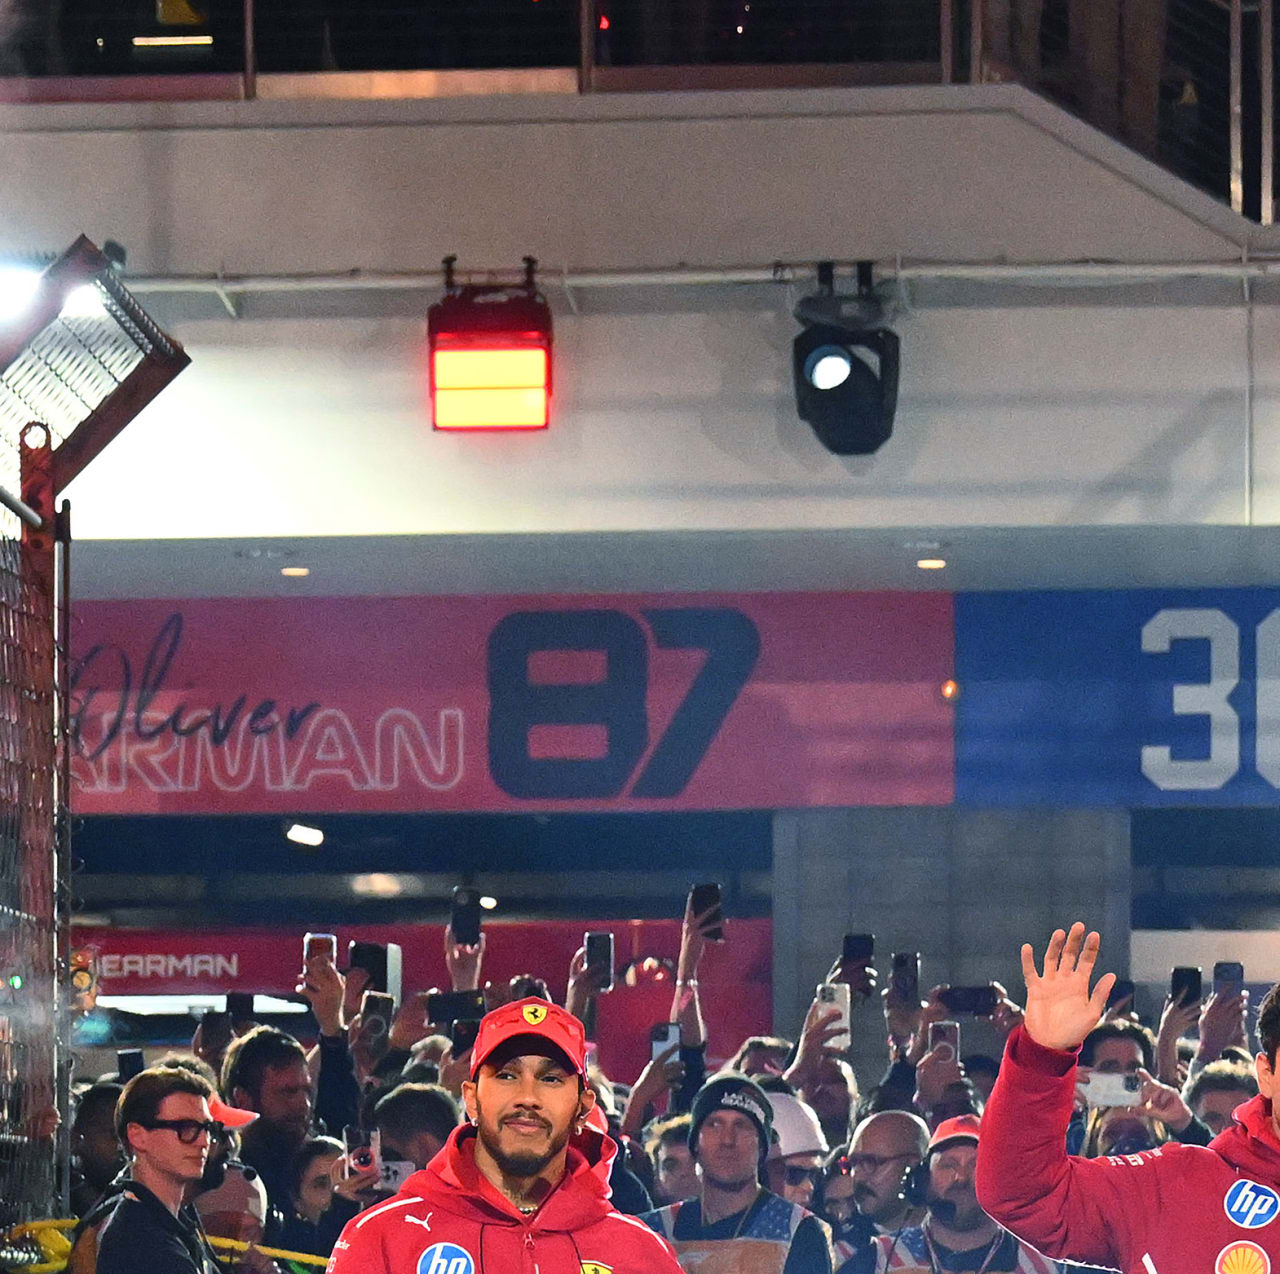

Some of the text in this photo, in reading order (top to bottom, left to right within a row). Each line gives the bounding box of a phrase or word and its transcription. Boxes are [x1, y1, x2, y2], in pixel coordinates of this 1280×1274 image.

[486, 606, 762, 800] 87
[96, 952, 240, 978] EARMAN
[1230, 1180, 1274, 1229] hp
